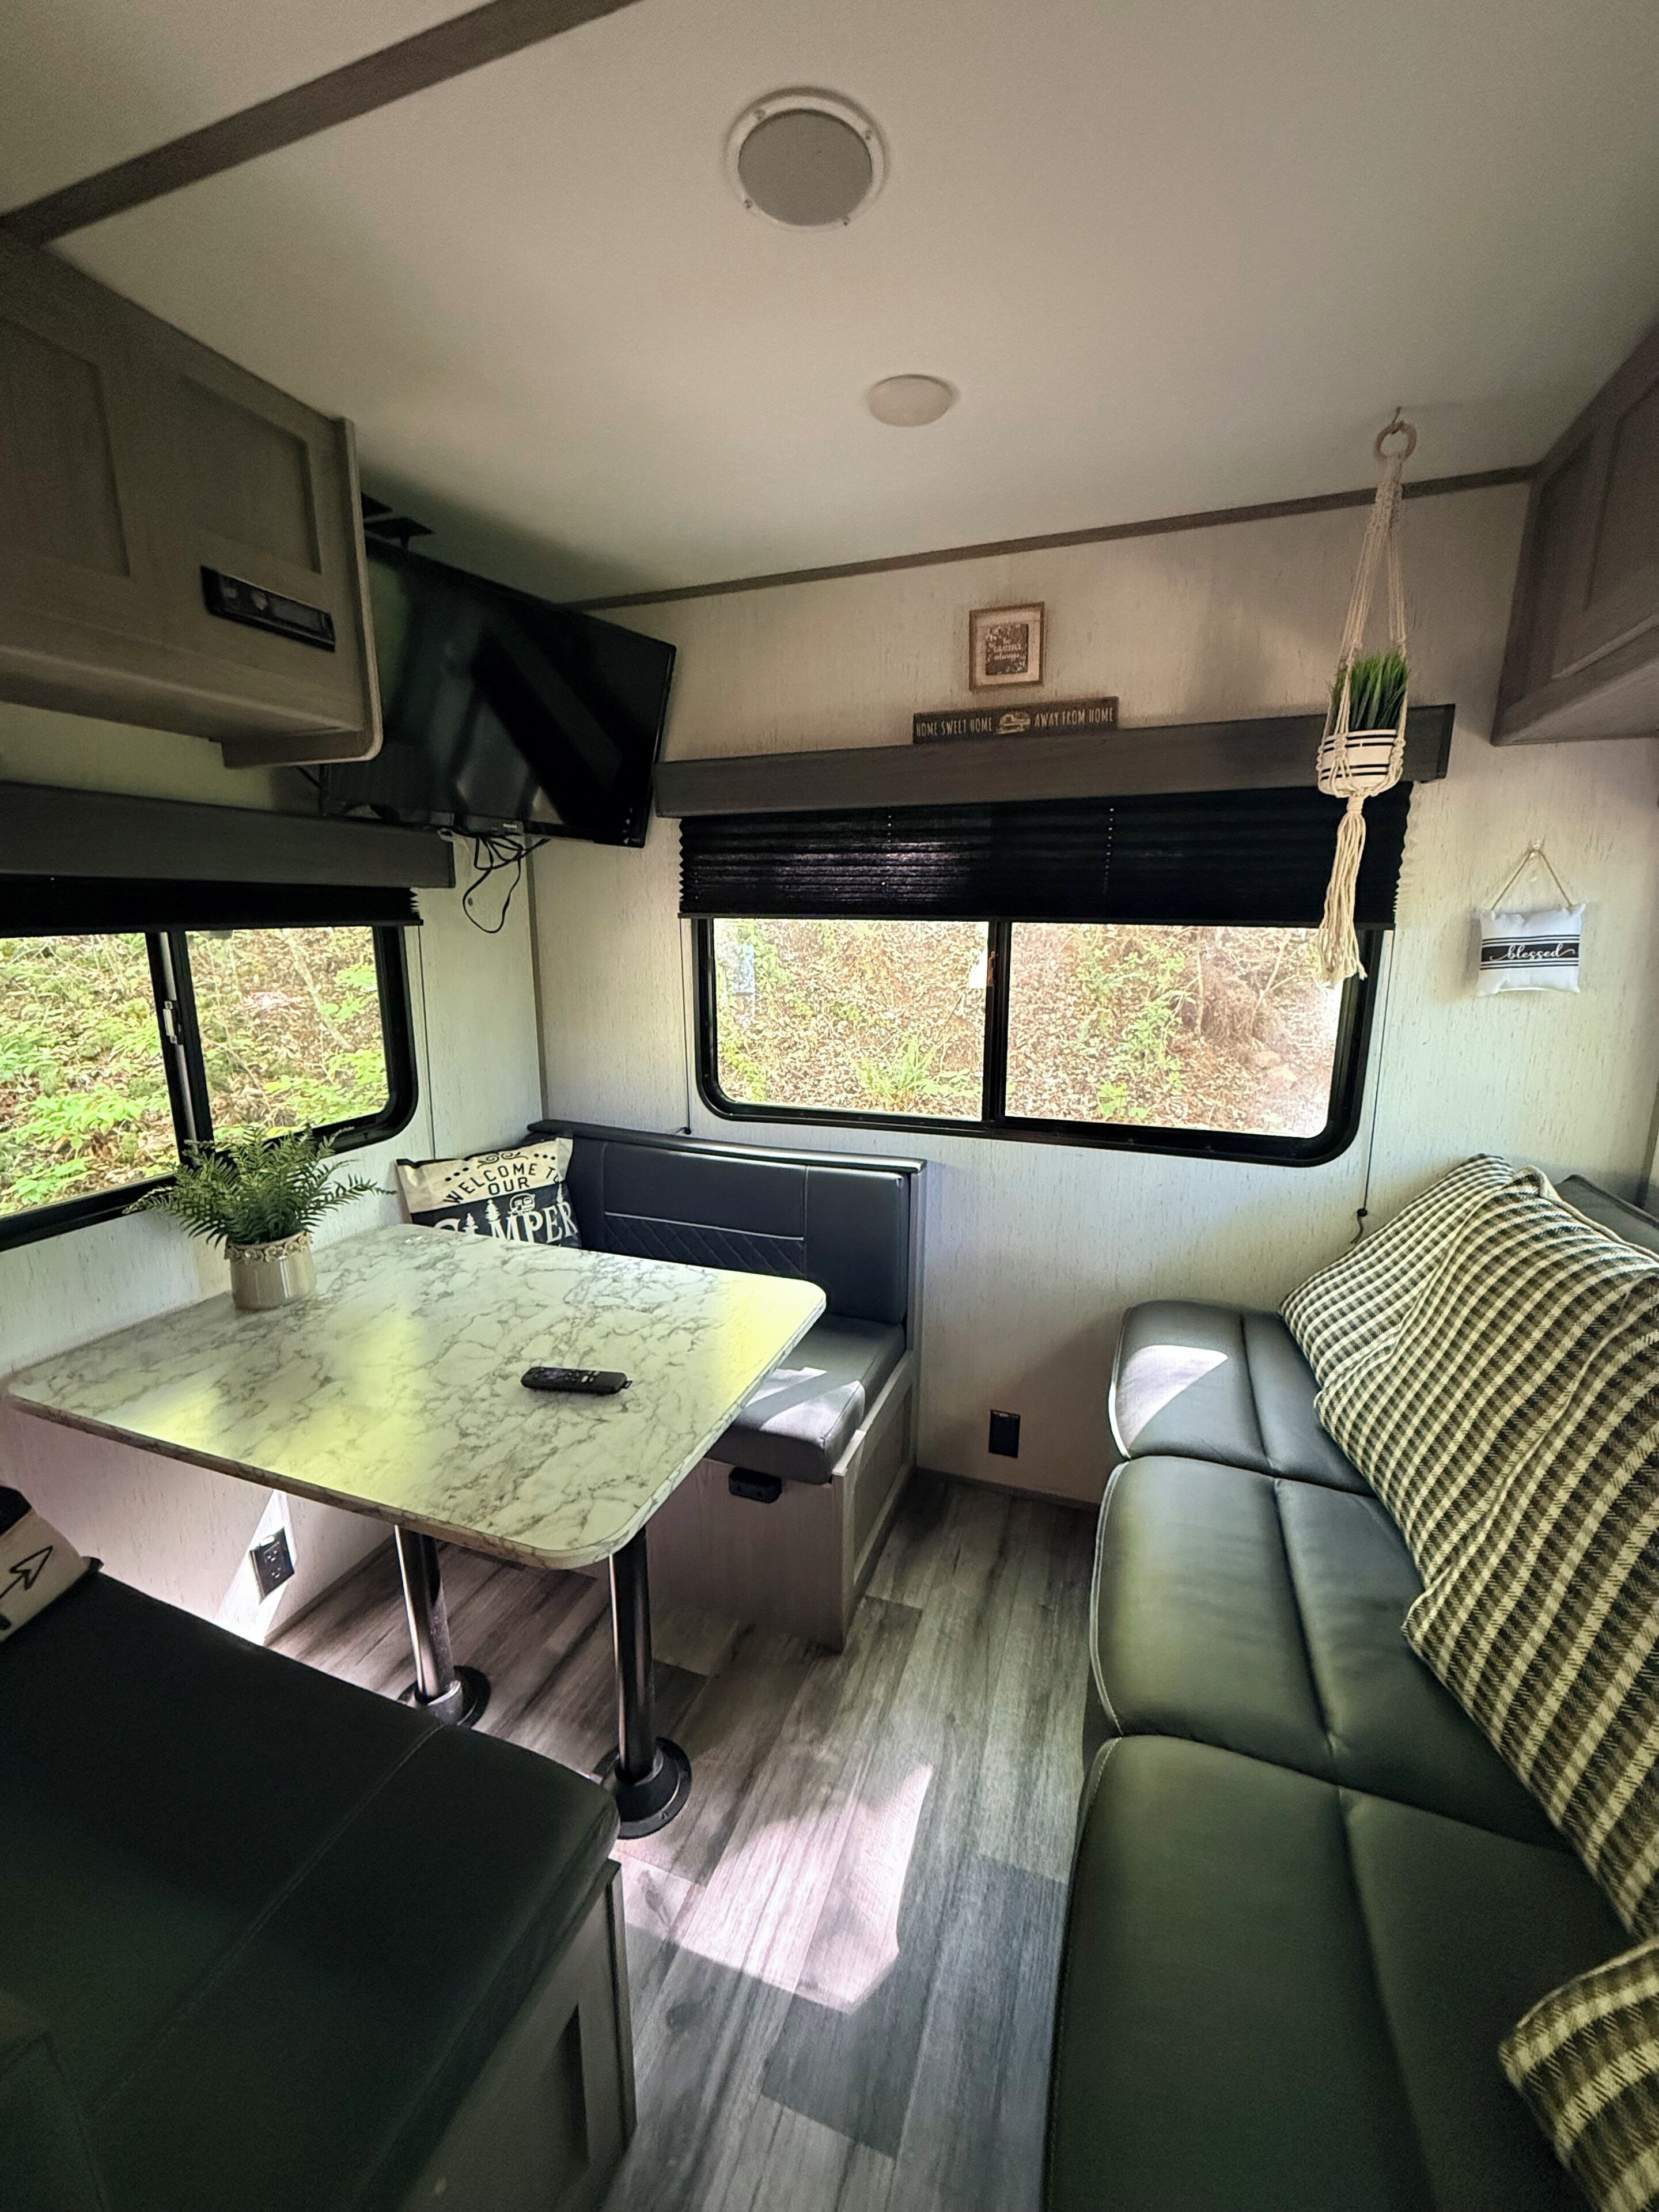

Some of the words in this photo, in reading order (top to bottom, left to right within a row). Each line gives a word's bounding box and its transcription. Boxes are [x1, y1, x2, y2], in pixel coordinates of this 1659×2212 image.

[916, 722, 938, 737] HOME
[941, 719, 967, 735] SWEET
[970, 717, 992, 733] HOME
[1034, 713, 1058, 728] AWAY
[1062, 710, 1085, 725] FROM
[1089, 707, 1113, 723] HOME
[1490, 943, 1575, 961] blessed
[442, 1162, 537, 1204] WELCOME
[488, 1177, 530, 1195] OUR
